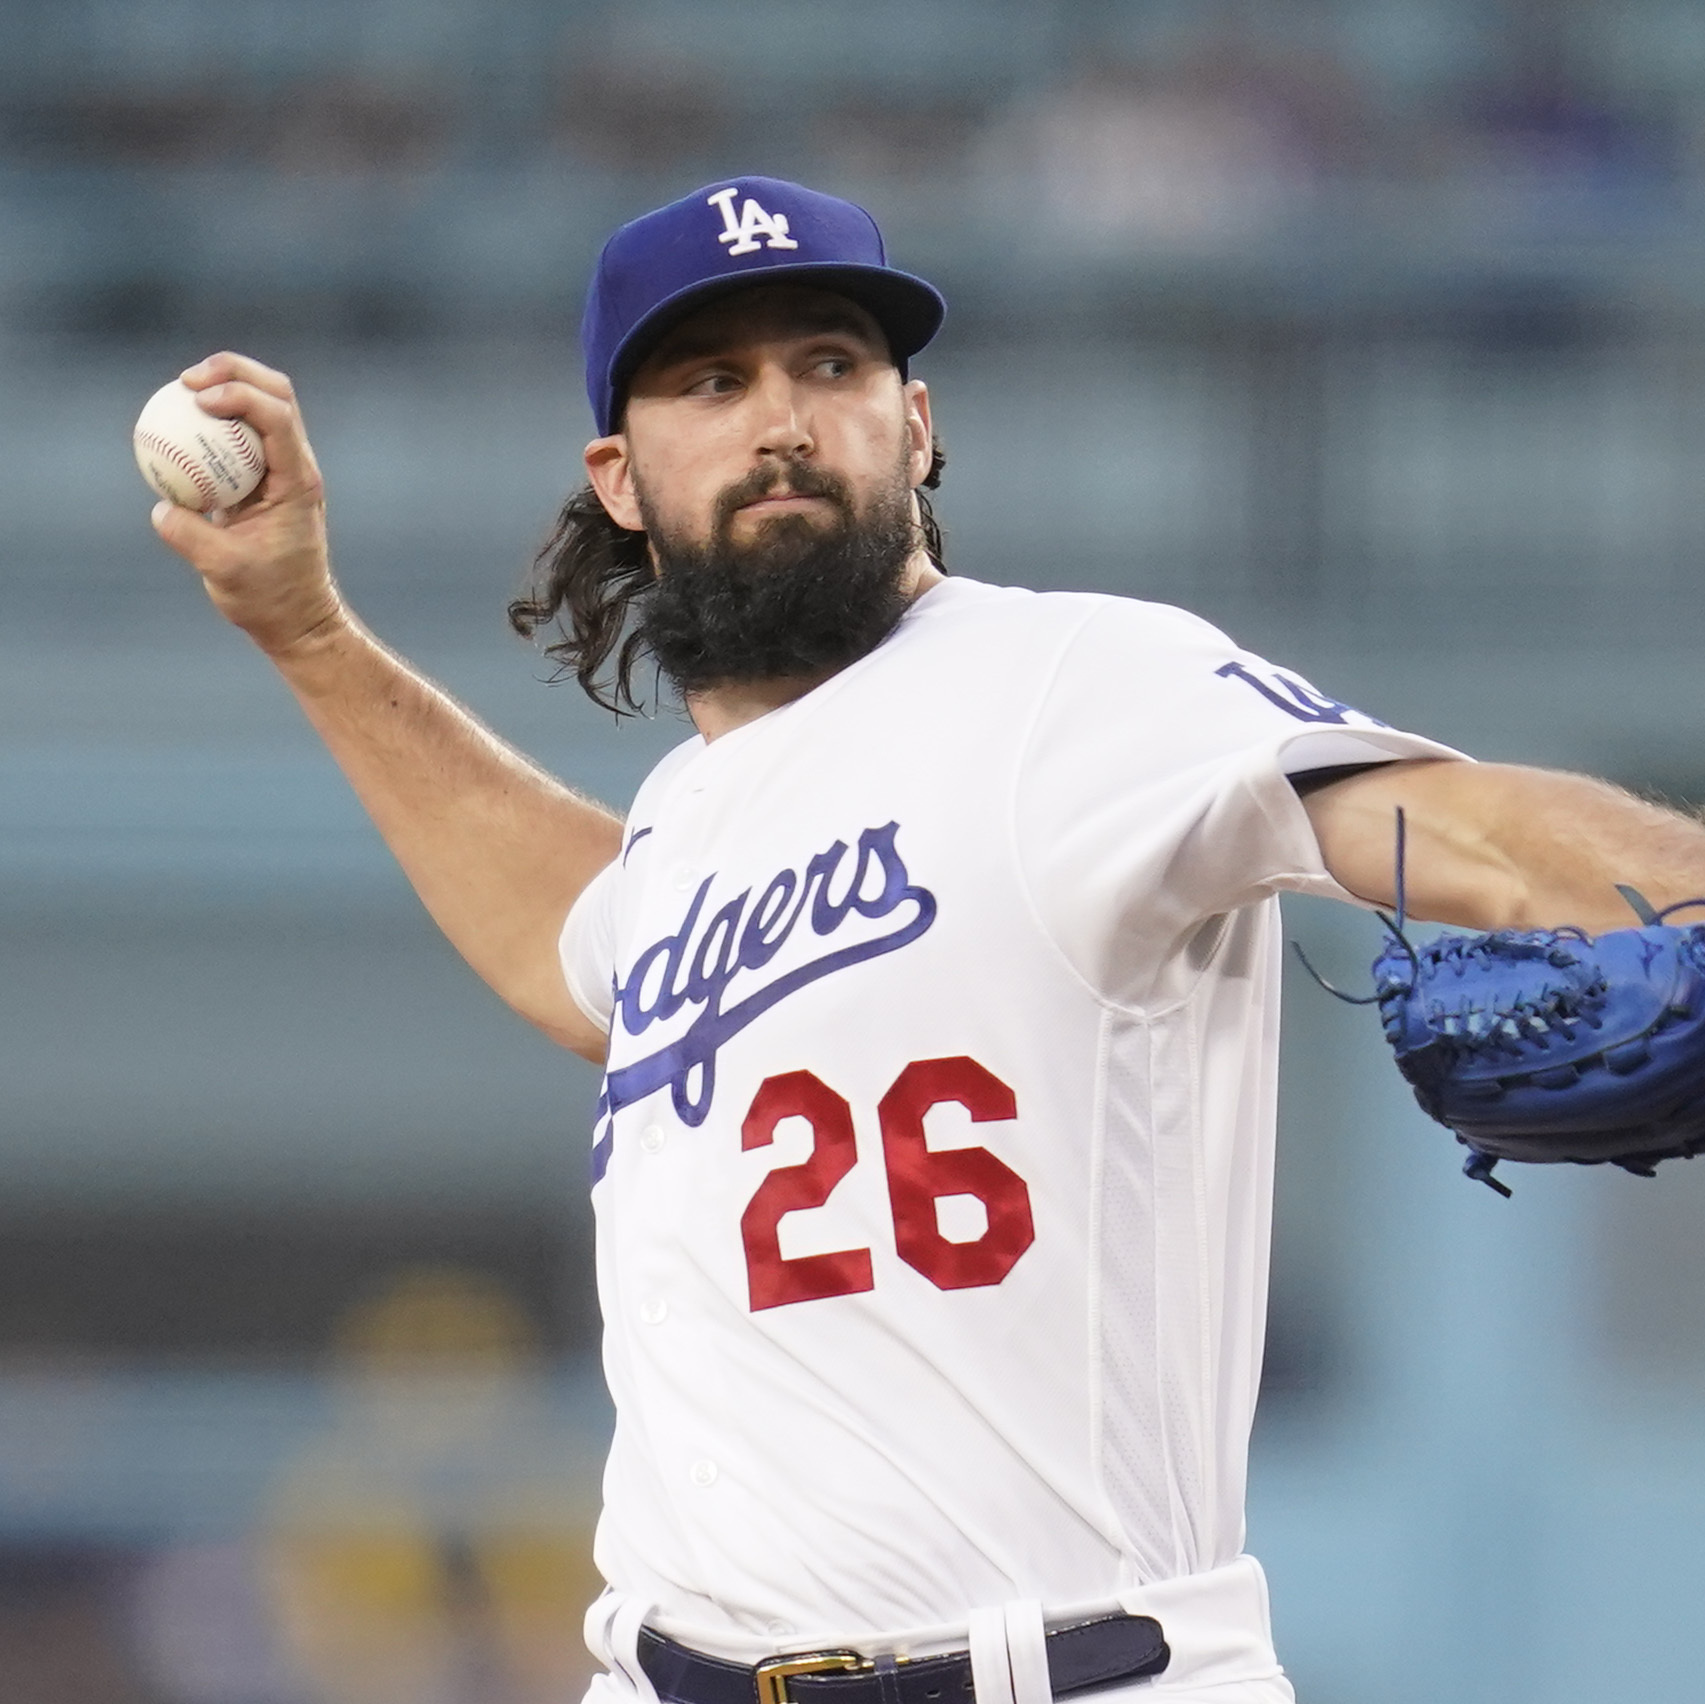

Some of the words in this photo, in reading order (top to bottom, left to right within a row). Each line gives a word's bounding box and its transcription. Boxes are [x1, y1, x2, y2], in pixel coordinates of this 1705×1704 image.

[707, 187, 799, 257] LA
[591, 820, 938, 1186] dgers
[740, 1055, 1036, 1312] 26
